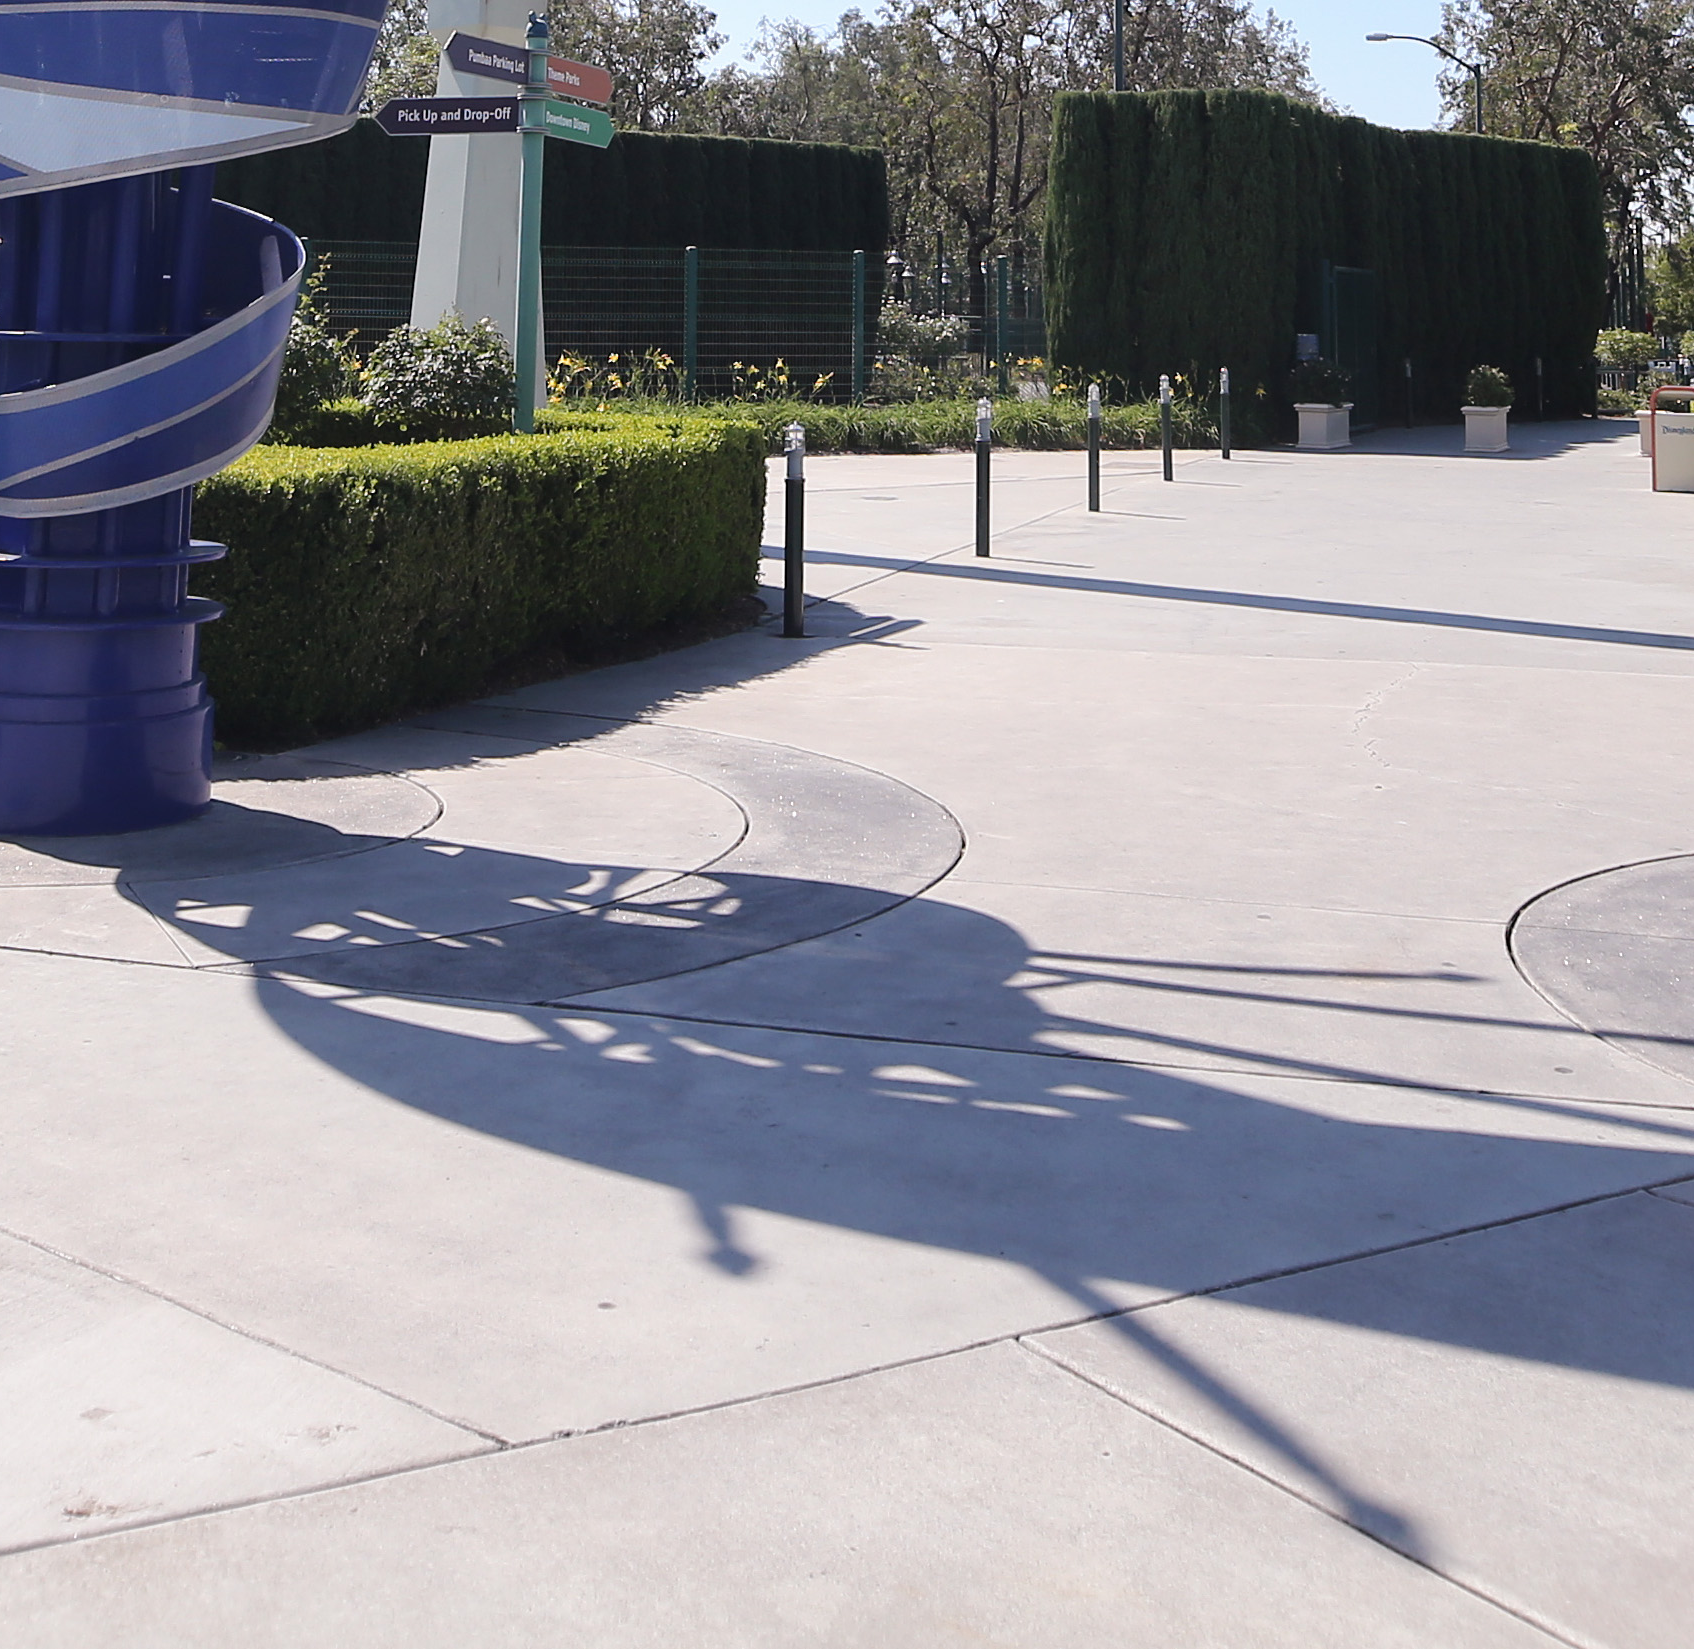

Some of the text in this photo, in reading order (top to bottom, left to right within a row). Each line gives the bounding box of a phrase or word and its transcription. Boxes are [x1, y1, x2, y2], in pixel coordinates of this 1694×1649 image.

[468, 49, 525, 74] Pumbaa Parking Lot
[548, 67, 581, 87] Theme Parks
[398, 107, 512, 124] Pick Up and Drop-Off
[546, 111, 590, 135] Downtown Disney
